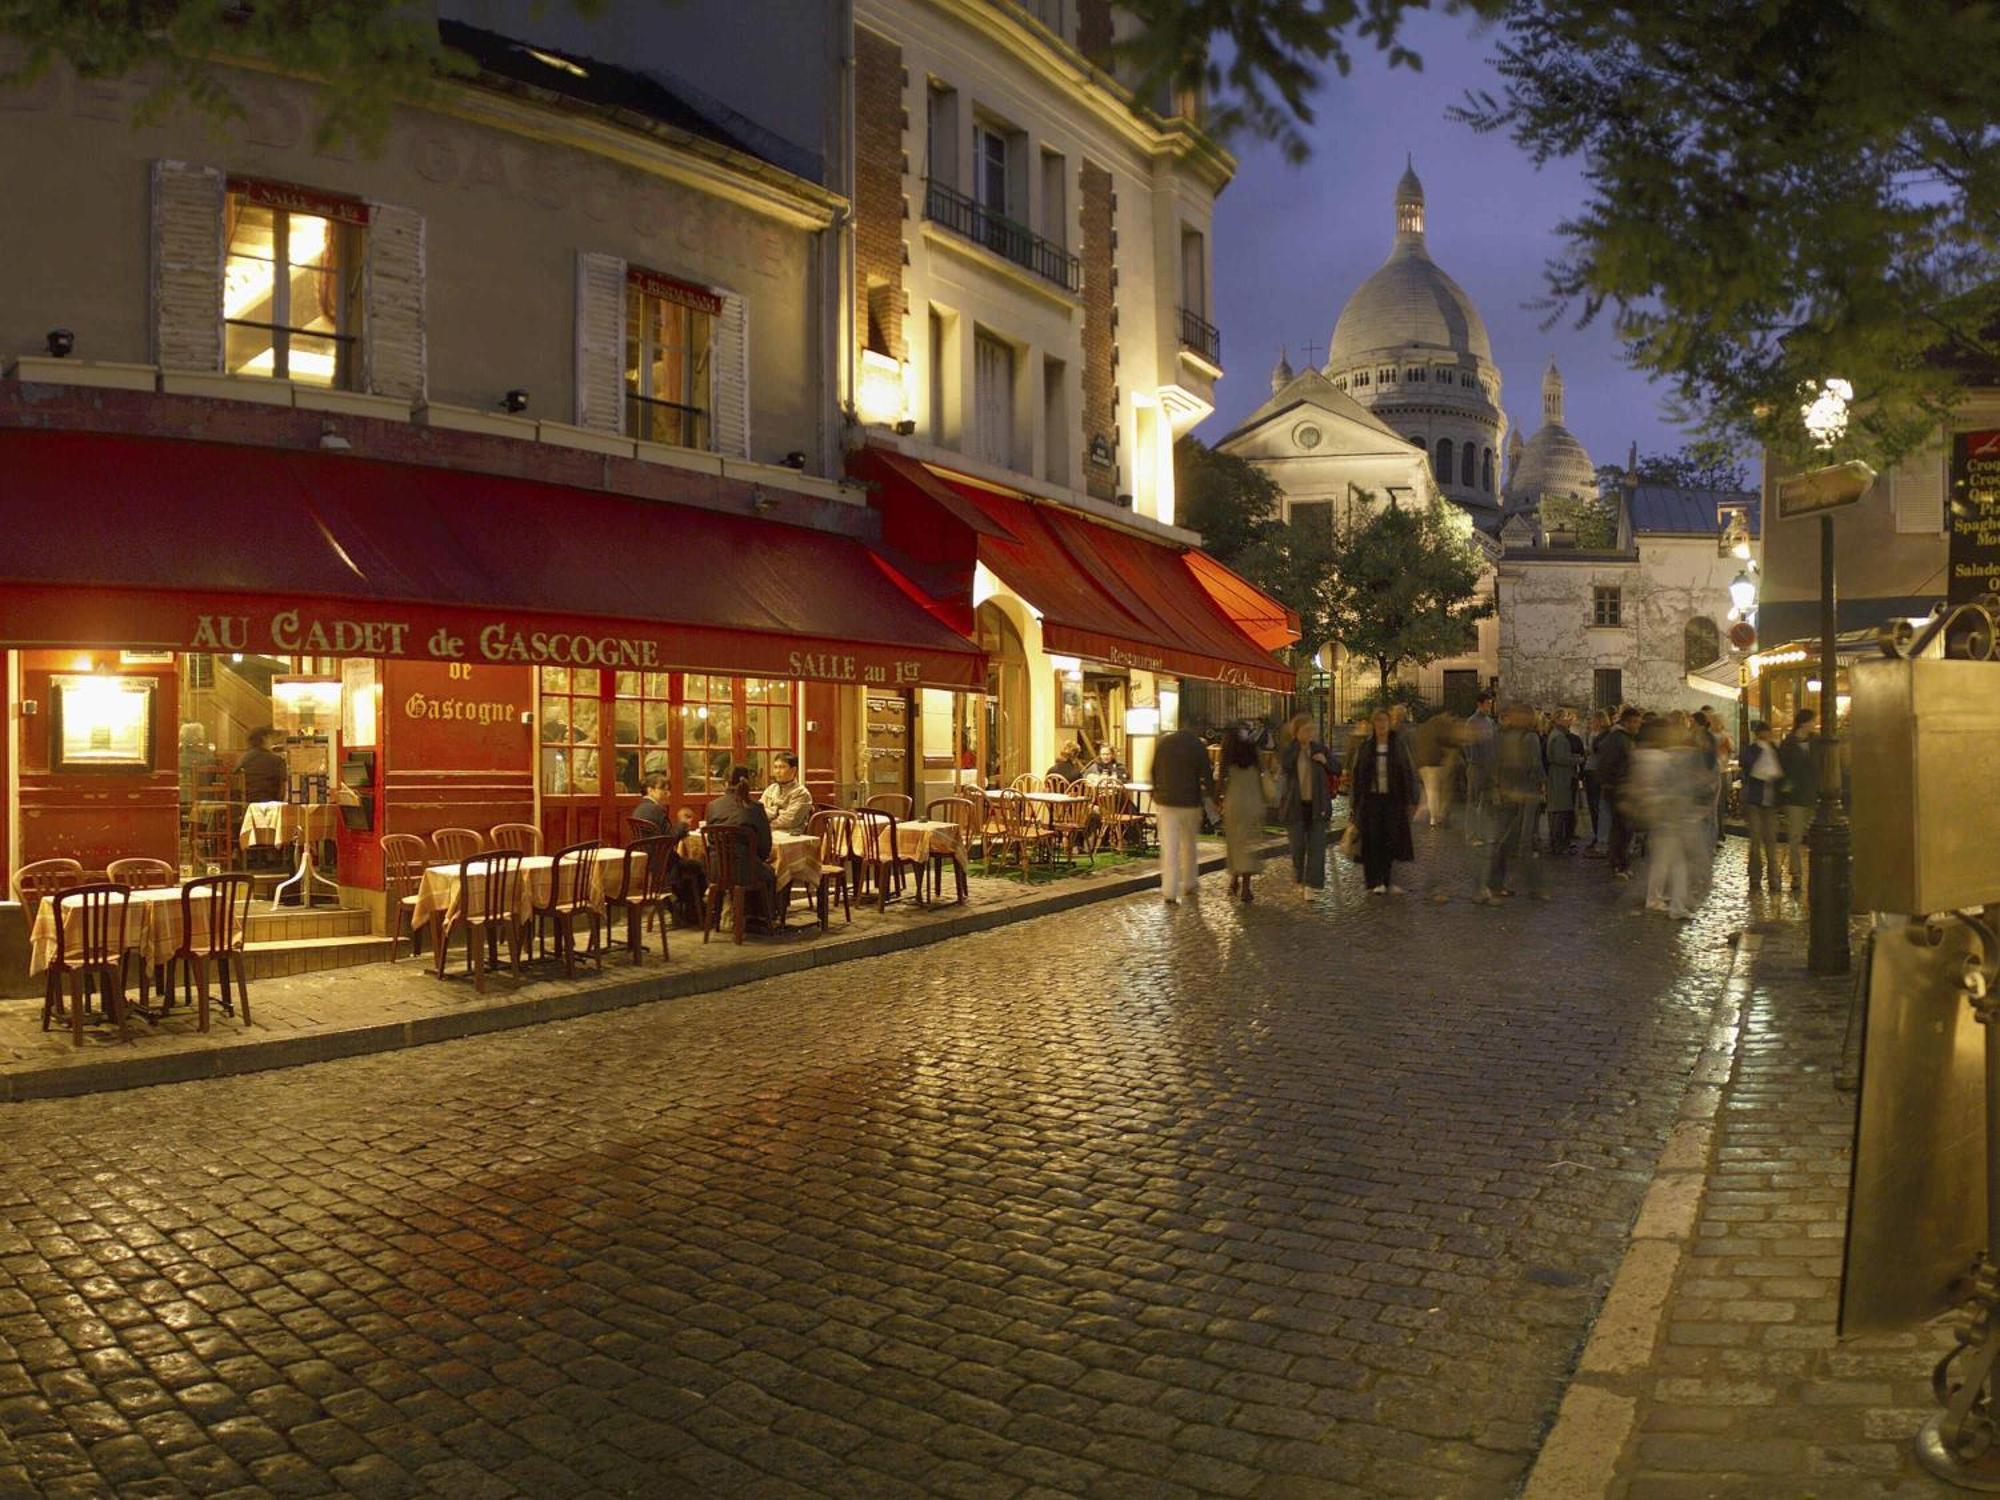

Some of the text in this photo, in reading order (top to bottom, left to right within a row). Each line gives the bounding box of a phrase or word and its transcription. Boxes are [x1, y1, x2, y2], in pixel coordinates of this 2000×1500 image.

[192, 609, 660, 668] AU CADET de GASCOGNE
[788, 650, 856, 681] SALLE
[864, 664, 886, 683] au
[404, 692, 515, 727] Gascogne
